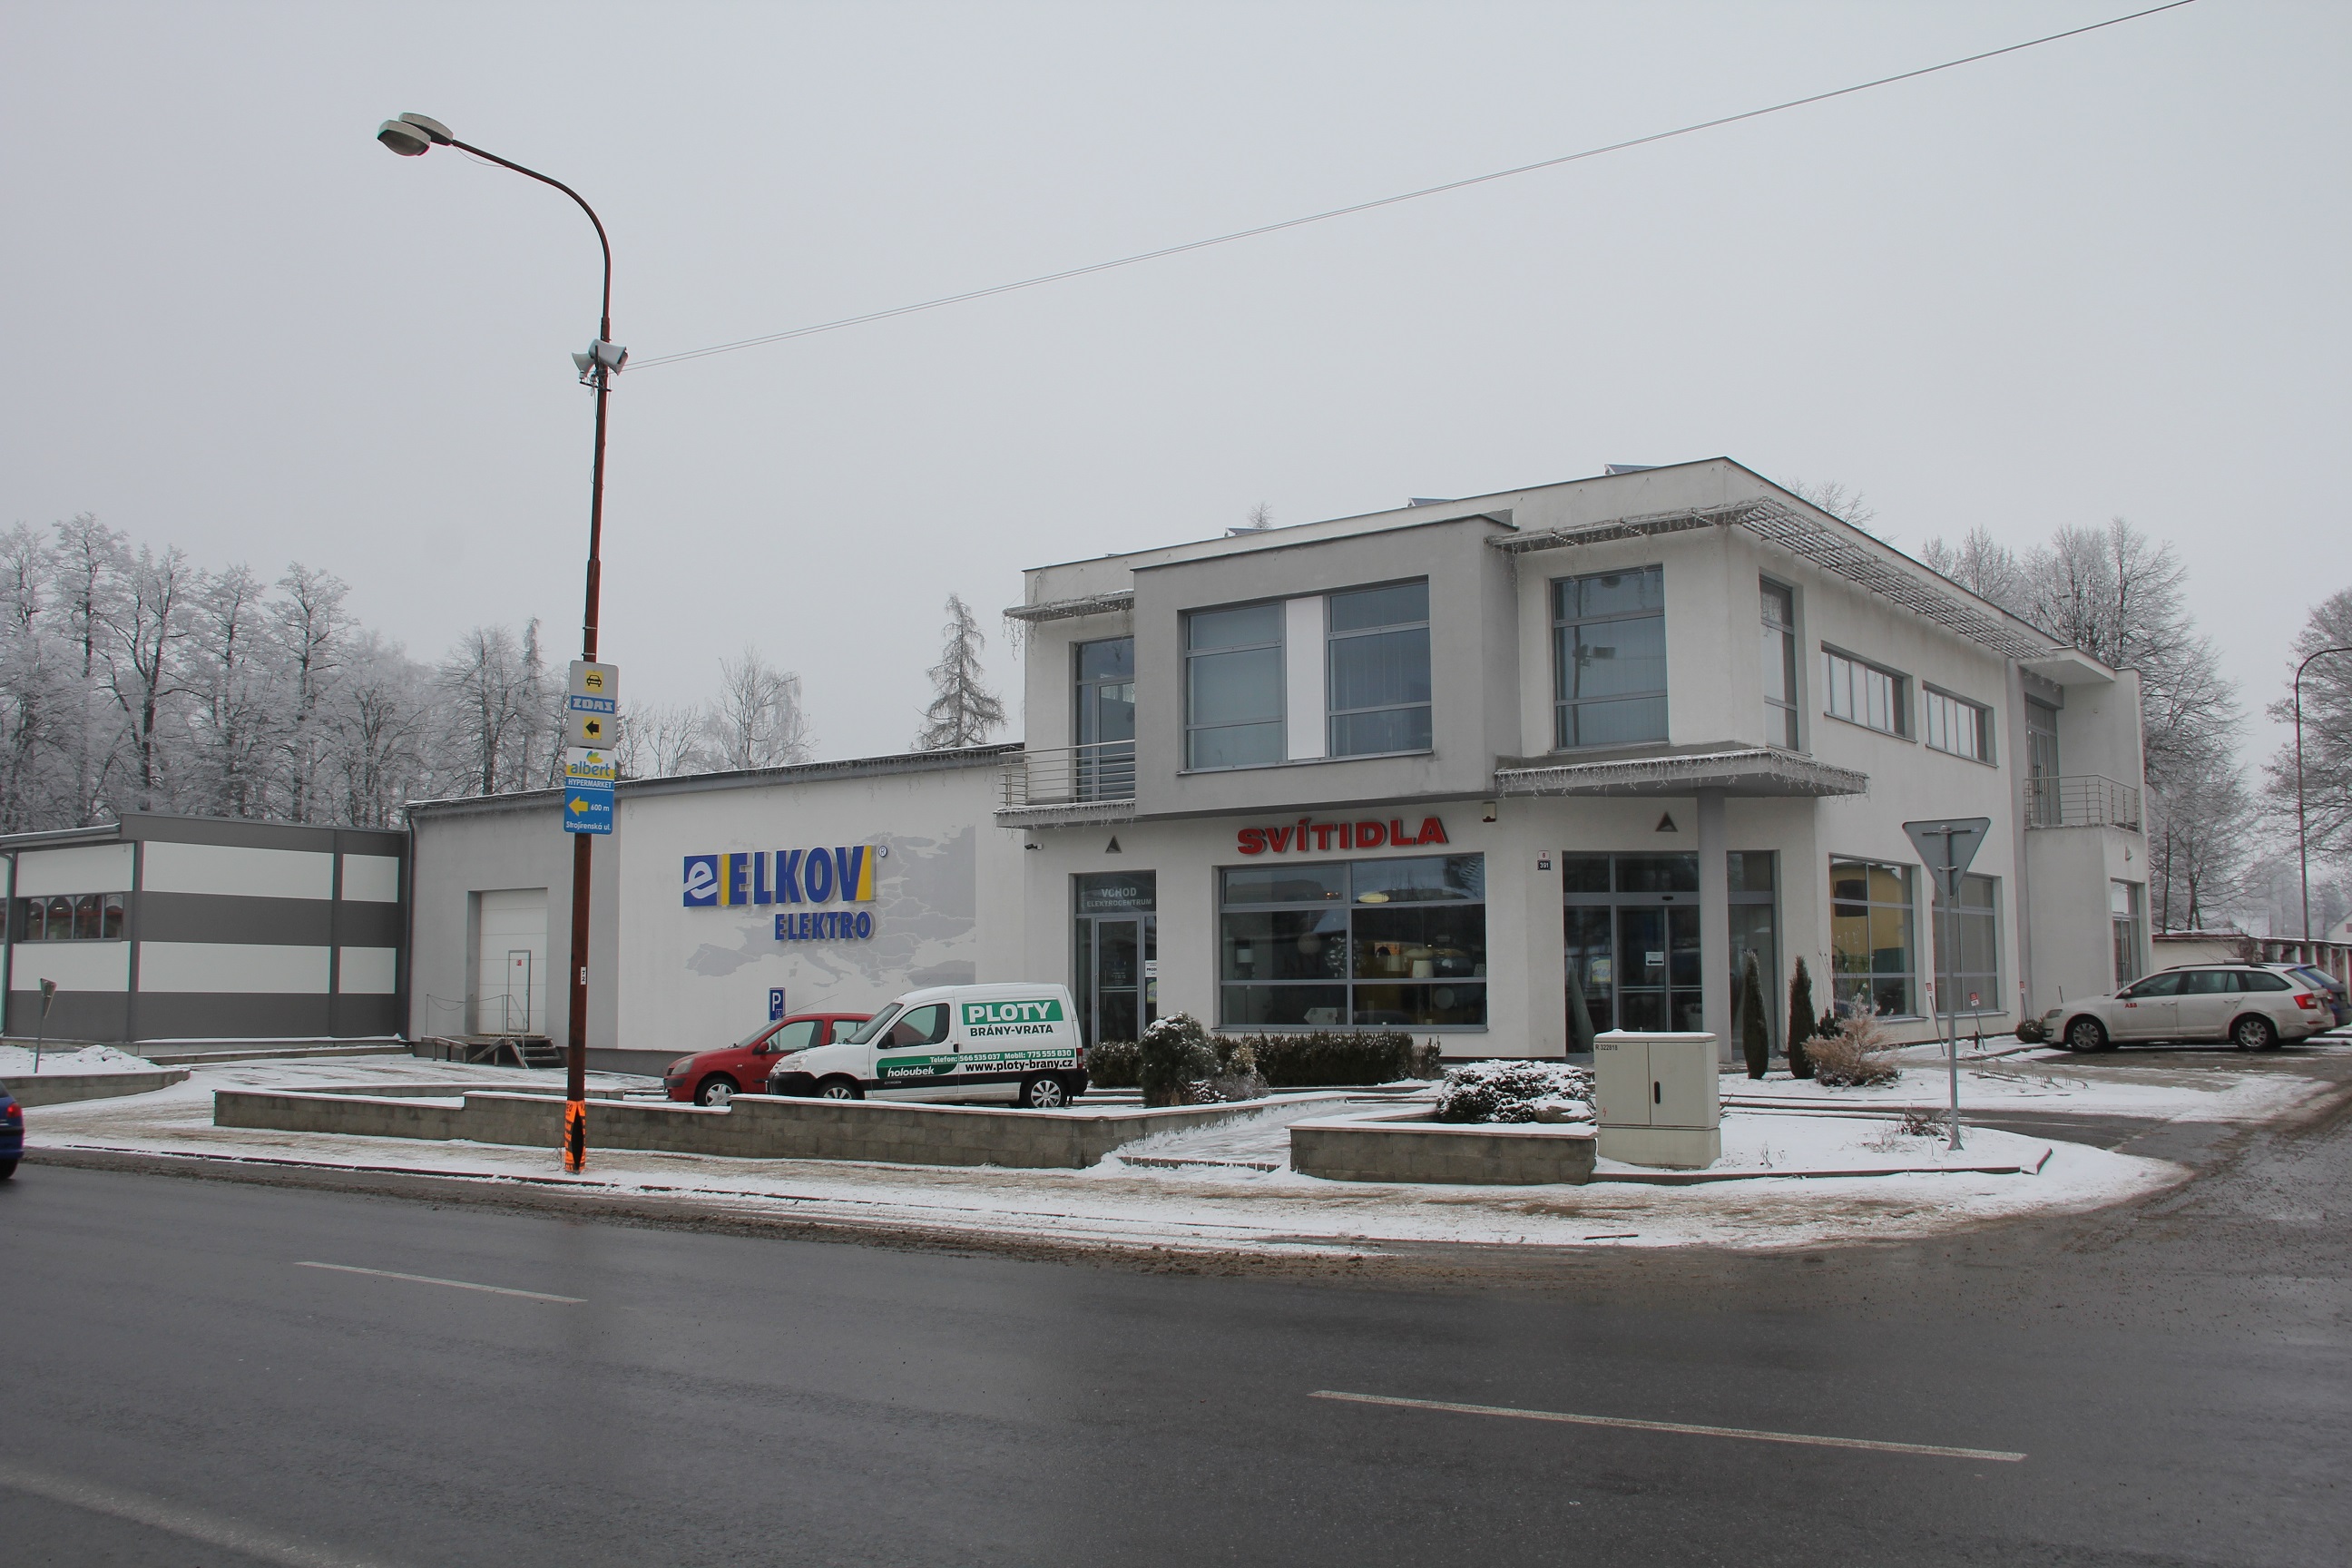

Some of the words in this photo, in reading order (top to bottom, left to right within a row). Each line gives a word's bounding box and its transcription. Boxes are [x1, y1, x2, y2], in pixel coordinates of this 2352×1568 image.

[571, 760, 611, 777] albert
[568, 778, 612, 789] HYPERMARKET
[591, 803, 603, 811] 600
[565, 820, 603, 830] Strojírenská
[603, 823, 612, 831] ul.
[1237, 817, 1449, 855] SVÍTIDLA
[730, 846, 868, 905] ELKOV
[1101, 887, 1137, 897] VCHOD
[1086, 898, 1152, 907] ELEKTROCENTRUM
[774, 910, 874, 941] ELEKTRO
[772, 992, 781, 1012] P
[968, 1001, 1052, 1024] PLOTY
[970, 1024, 1054, 1037] BRÁNY-VRATA
[929, 1055, 958, 1063] Telefon:
[1004, 1052, 1026, 1060] Mobil:
[1057, 1049, 1072, 1057] 830
[887, 1065, 935, 1078] holoubek
[965, 1060, 1073, 1072] www.ploty-brany.cz
